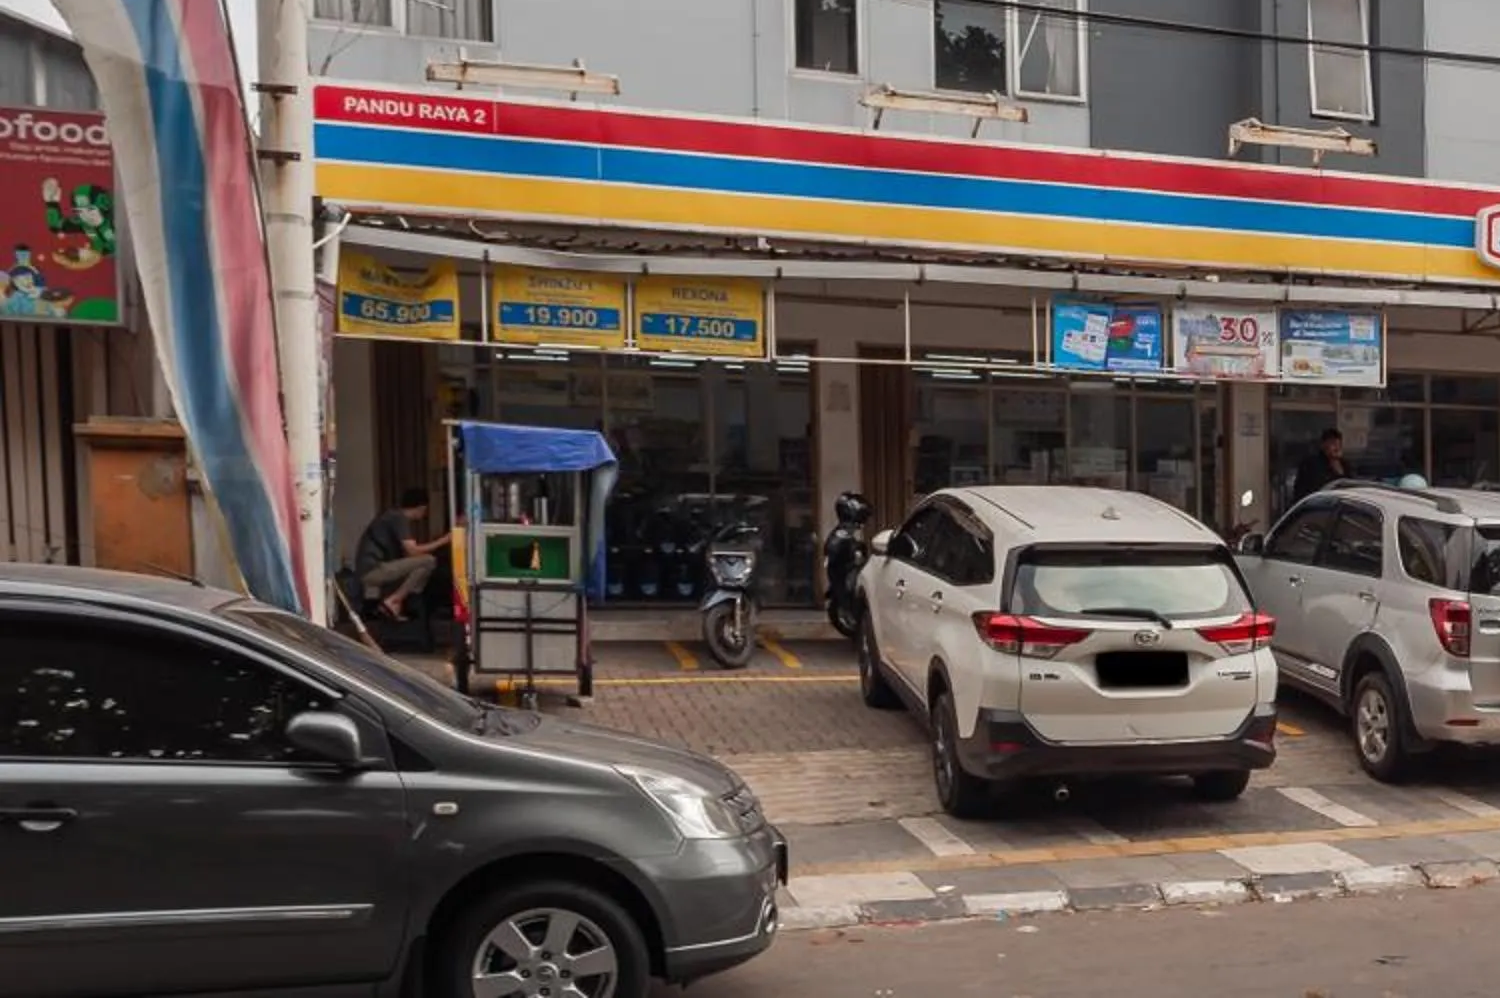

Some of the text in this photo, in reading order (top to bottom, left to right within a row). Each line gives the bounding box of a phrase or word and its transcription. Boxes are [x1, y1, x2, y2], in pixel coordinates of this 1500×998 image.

[343, 96, 487, 125] PANDU RAYA 2
[524, 306, 597, 327] 19.900
[665, 316, 735, 338] 17.500
[1220, 316, 1257, 343] 30
